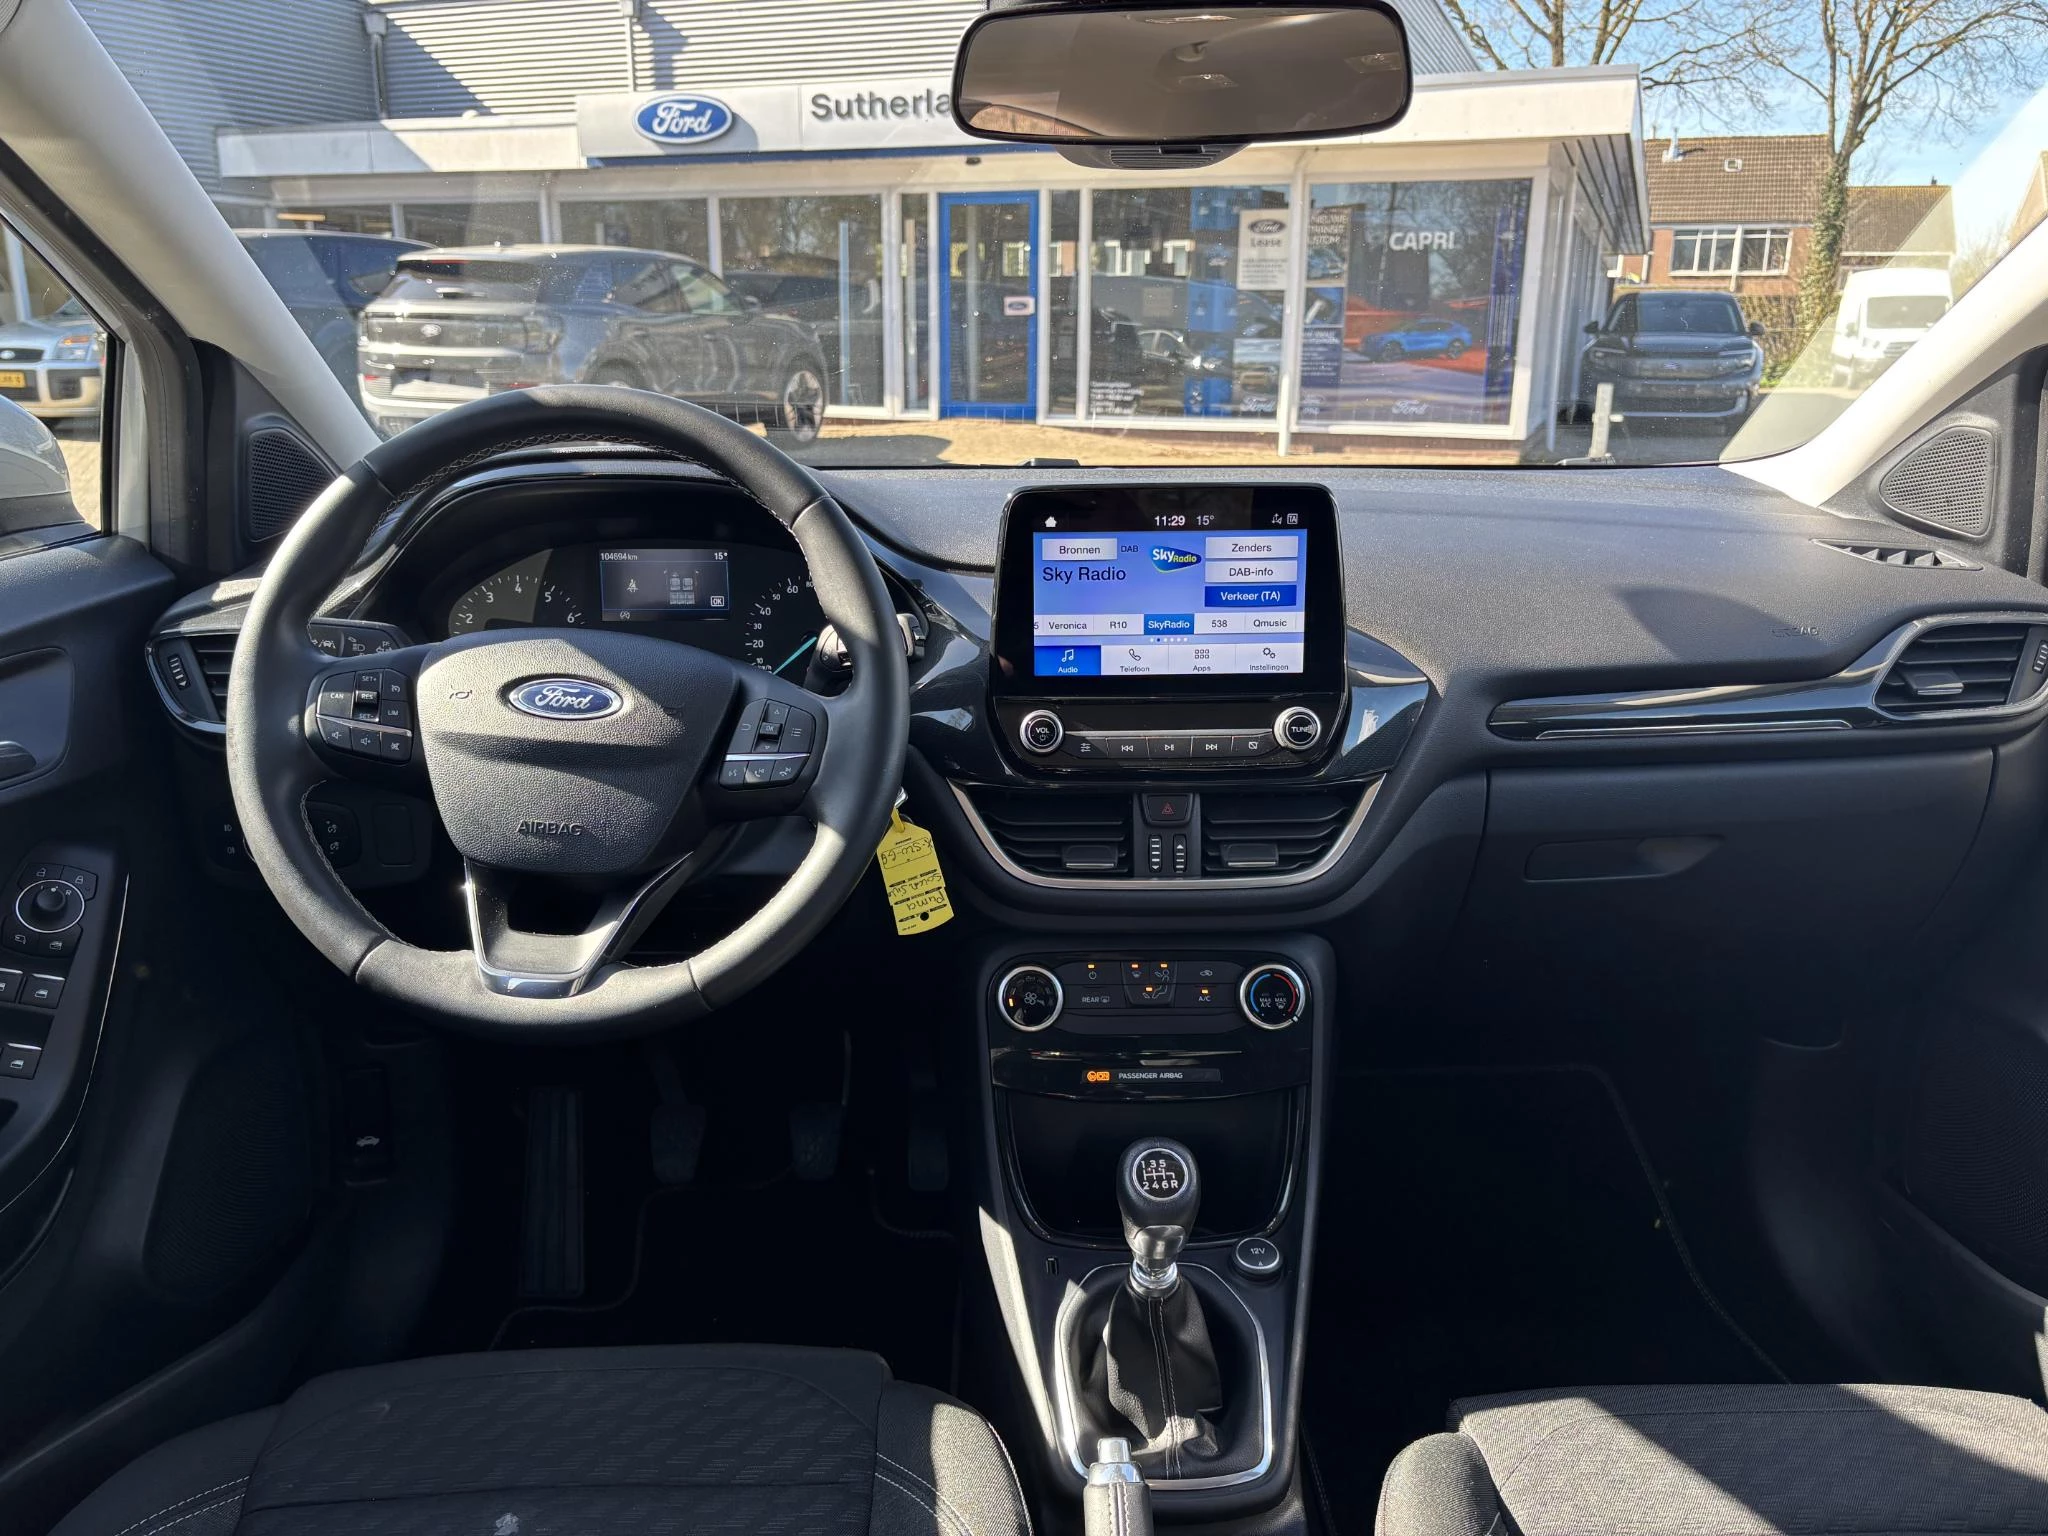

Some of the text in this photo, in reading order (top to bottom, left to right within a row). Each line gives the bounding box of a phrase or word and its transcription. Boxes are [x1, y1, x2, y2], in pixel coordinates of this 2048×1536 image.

[811, 88, 951, 121] Sutherla
[652, 101, 714, 135] Ford
[1389, 231, 1455, 250] CAPRI
[1154, 515, 1215, 526] 11:29 15°
[1059, 545, 1100, 555] Bronnen
[1120, 545, 1139, 553] DAB
[1231, 543, 1272, 552] Zenders
[1152, 548, 1197, 563] Sky Radio
[1042, 567, 1126, 584] Sky Radio
[1229, 567, 1274, 577] DAB-info
[514, 583, 523, 593] 4
[786, 585, 798, 594] 60
[486, 592, 494, 603] 3
[544, 592, 552, 602] 5
[772, 593, 781, 601] 50
[1220, 590, 1281, 602] Verkeer (TA)
[759, 607, 771, 616] 40
[465, 613, 473, 624] 2
[567, 612, 575, 623] 6
[1048, 622, 1087, 630] Veronica
[1109, 621, 1127, 629] R10
[1148, 620, 1190, 630] SkyRadio
[1211, 619, 1228, 628] 538
[1253, 619, 1287, 627] Qmusic
[752, 639, 764, 649] 20
[756, 657, 763, 665] 10
[1120, 665, 1150, 673] Telefoon
[1193, 664, 1211, 672] Apps
[1249, 664, 1289, 672] Instellingen
[534, 685, 594, 709] Ford
[516, 819, 583, 836] AIRBAG
[1149, 1160, 1157, 1168] 3
[1159, 1160, 1166, 1168] 5
[1142, 1180, 1178, 1190] 2 4 6 R
